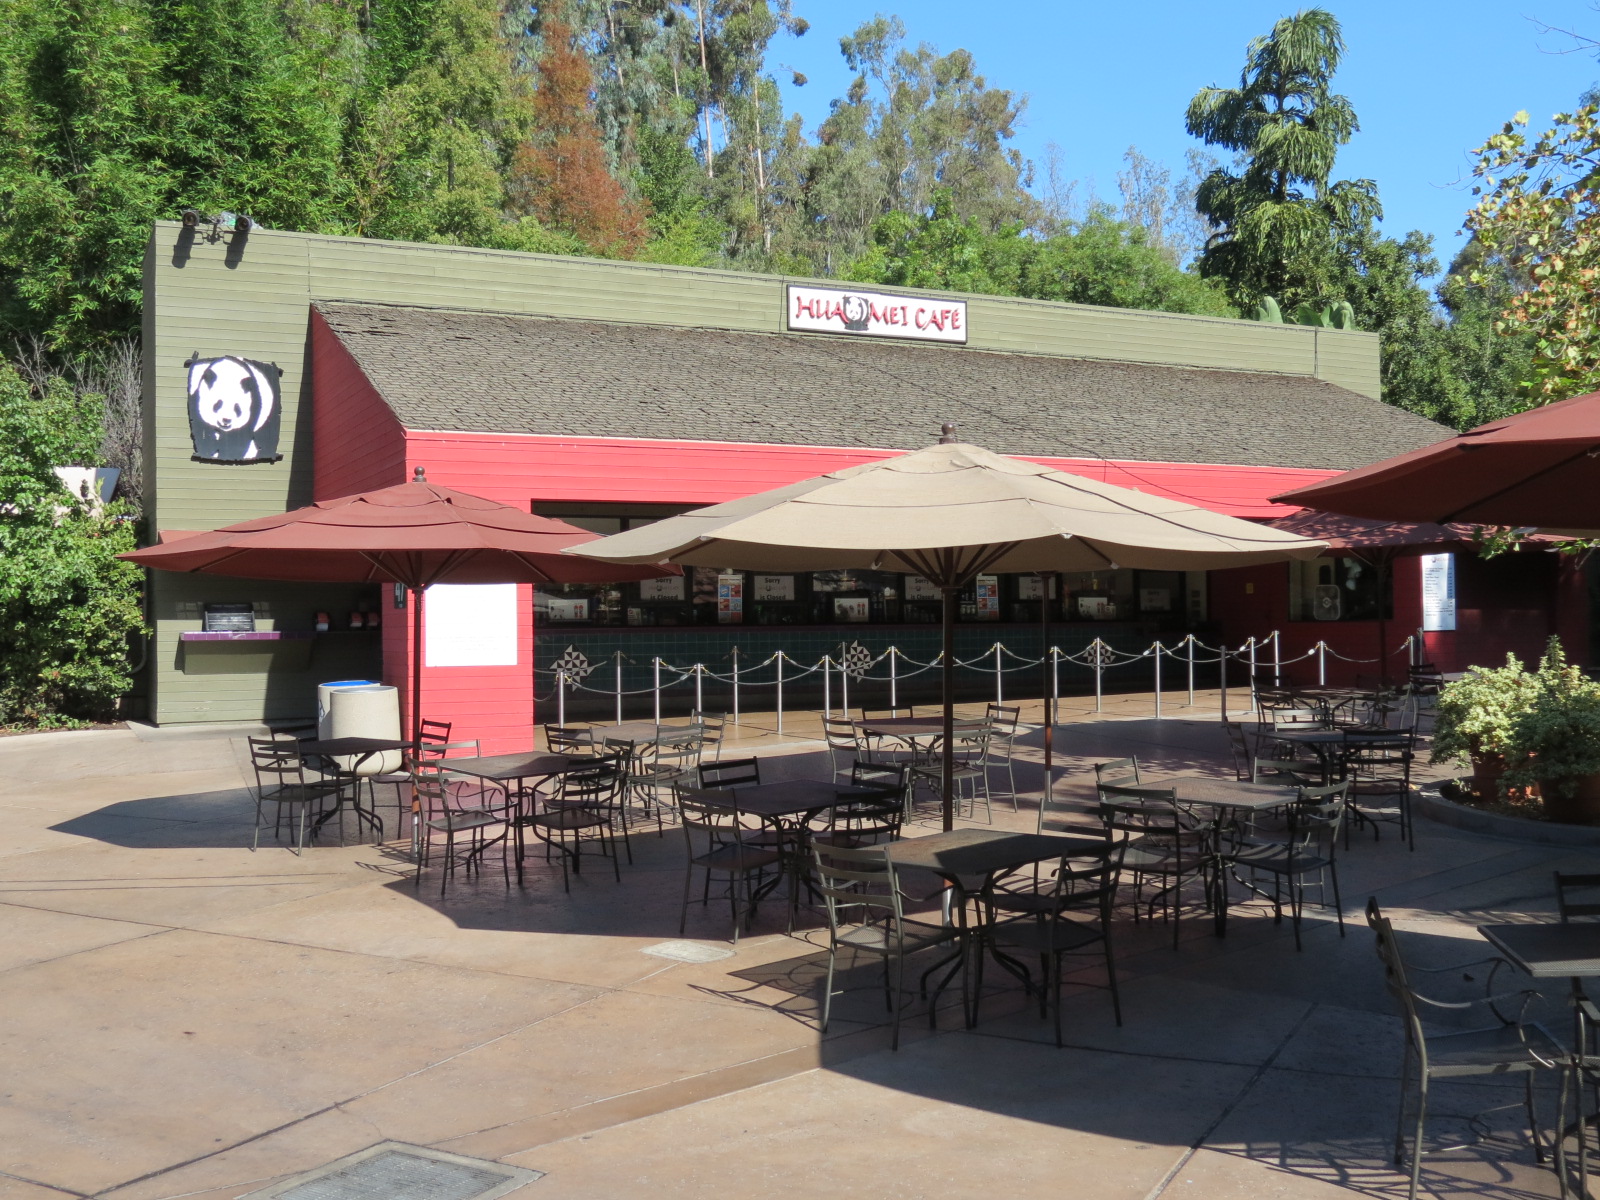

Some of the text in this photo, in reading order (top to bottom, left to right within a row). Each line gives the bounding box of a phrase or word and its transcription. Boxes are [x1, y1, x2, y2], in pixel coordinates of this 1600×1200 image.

[796, 295, 961, 331] HUA MEI CAFÉ
